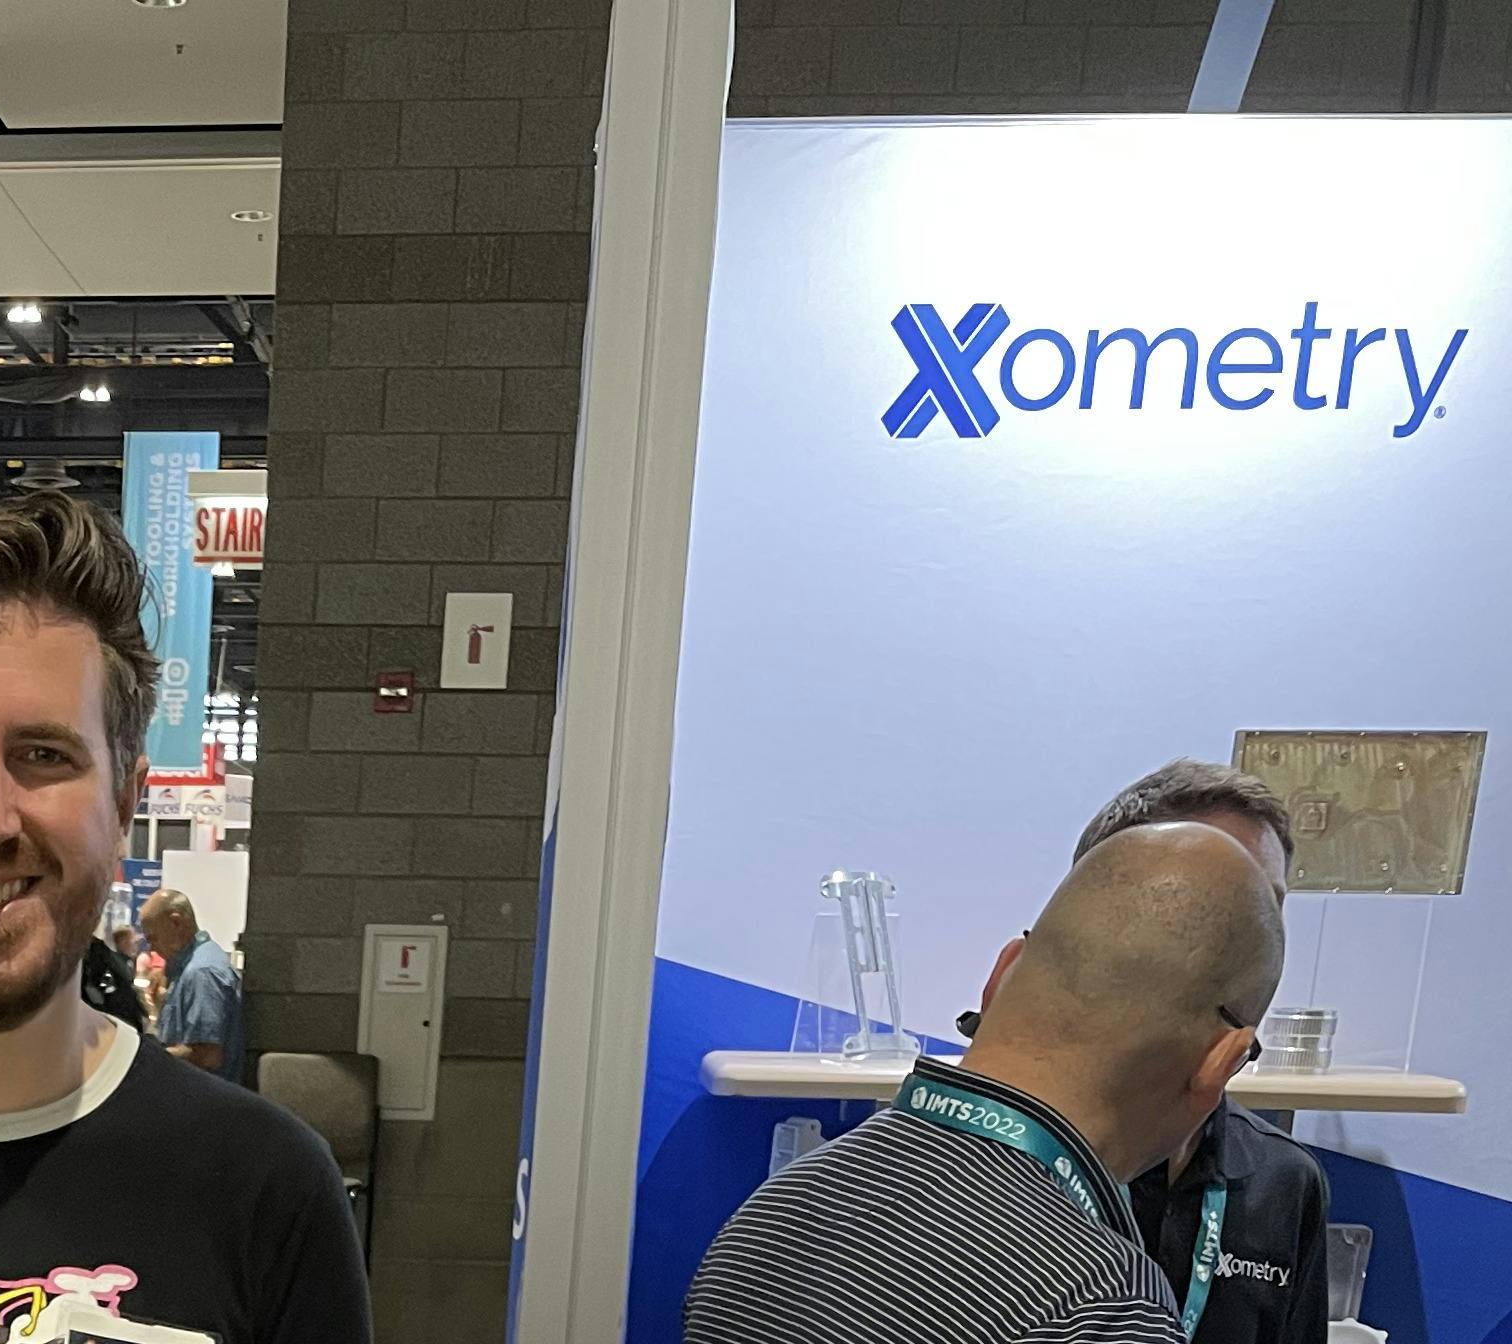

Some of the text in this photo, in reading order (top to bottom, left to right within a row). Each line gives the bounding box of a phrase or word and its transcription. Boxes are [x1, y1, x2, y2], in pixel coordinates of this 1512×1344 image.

[880, 301, 1470, 439] Xometry
[145, 472, 164, 566] TOOLING
[162, 452, 183, 617] WORKHOLDING
[195, 507, 263, 552] STAIR
[1214, 1253, 1290, 1287] Xometry
